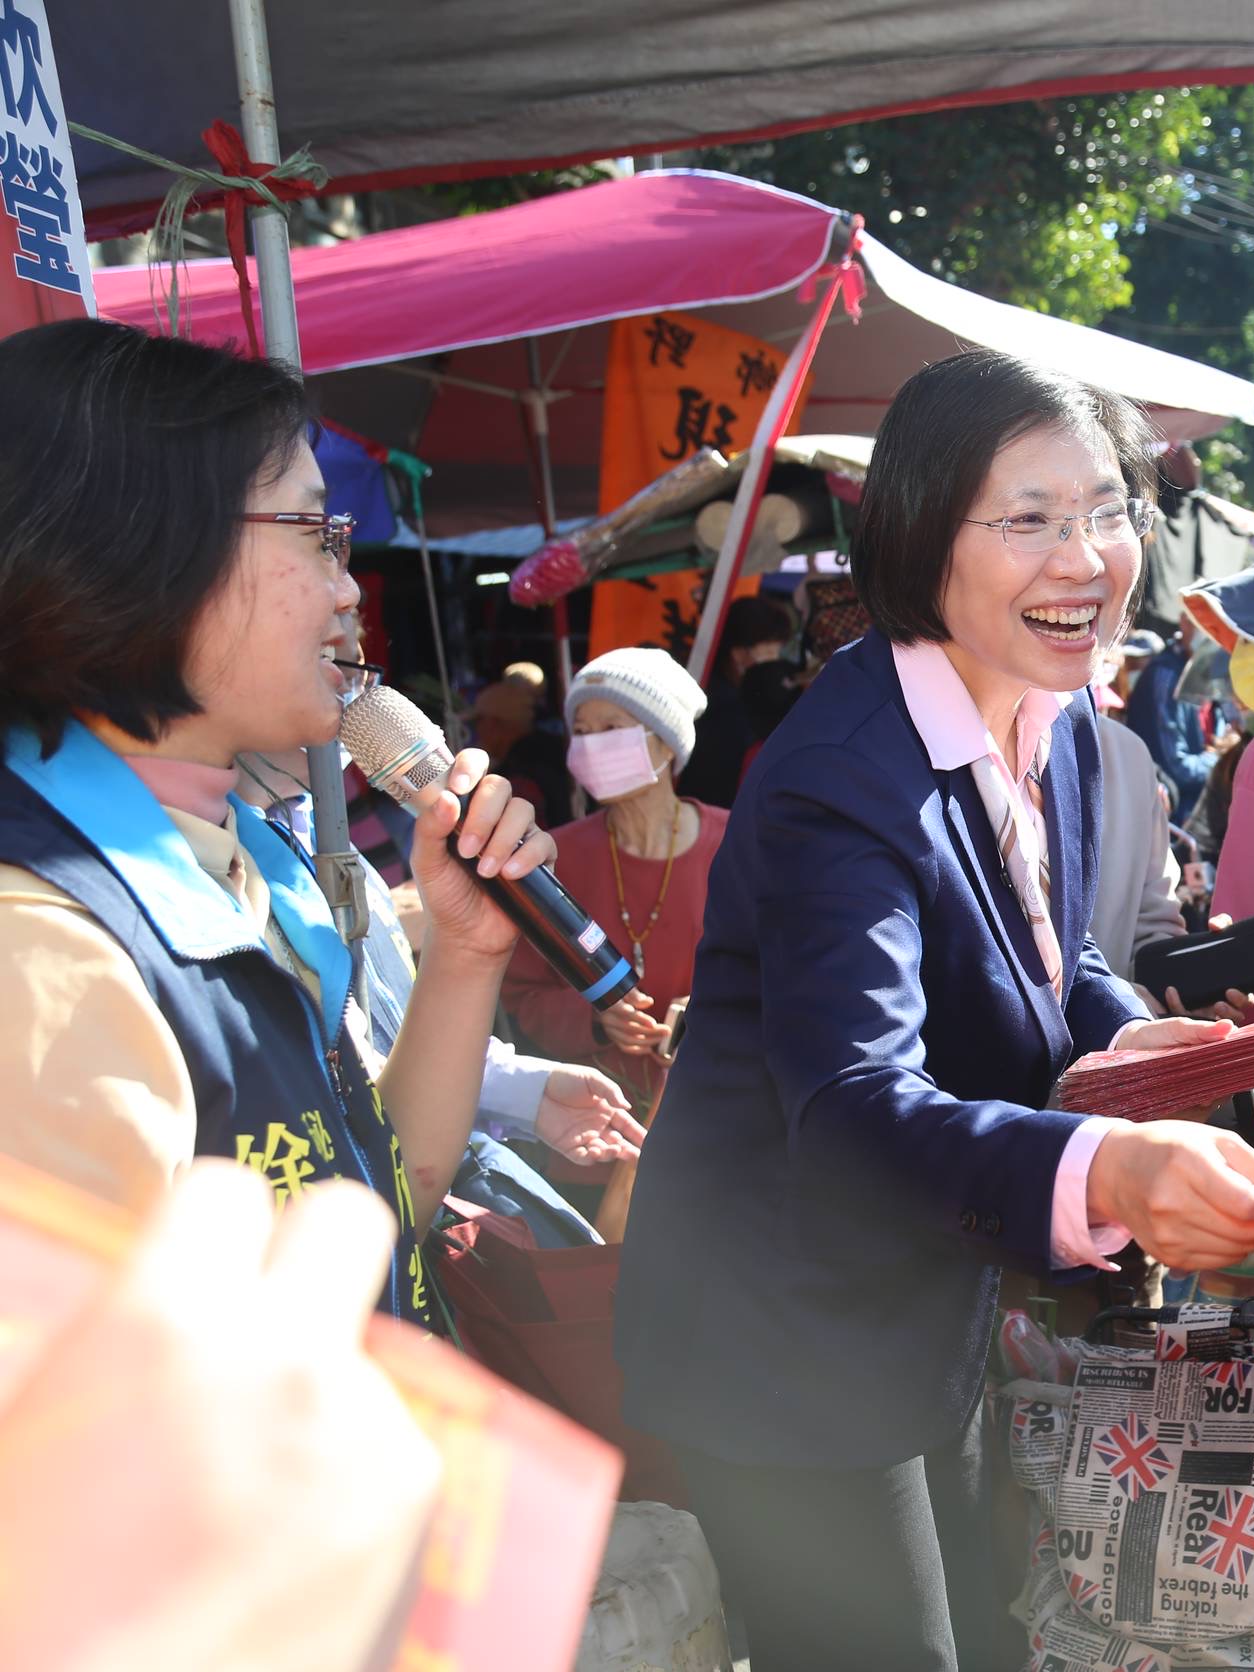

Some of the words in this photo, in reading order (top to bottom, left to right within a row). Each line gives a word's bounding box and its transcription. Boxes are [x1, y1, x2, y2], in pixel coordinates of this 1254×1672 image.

[1203, 1386, 1253, 1413] FOR
[1104, 1495, 1123, 1558] Place
[1182, 1488, 1219, 1564] Real
[1100, 1563, 1115, 1628] Going
[1158, 1577, 1217, 1600] fabrex
[1221, 1582, 1249, 1600] the
[1160, 1593, 1218, 1618] taking
